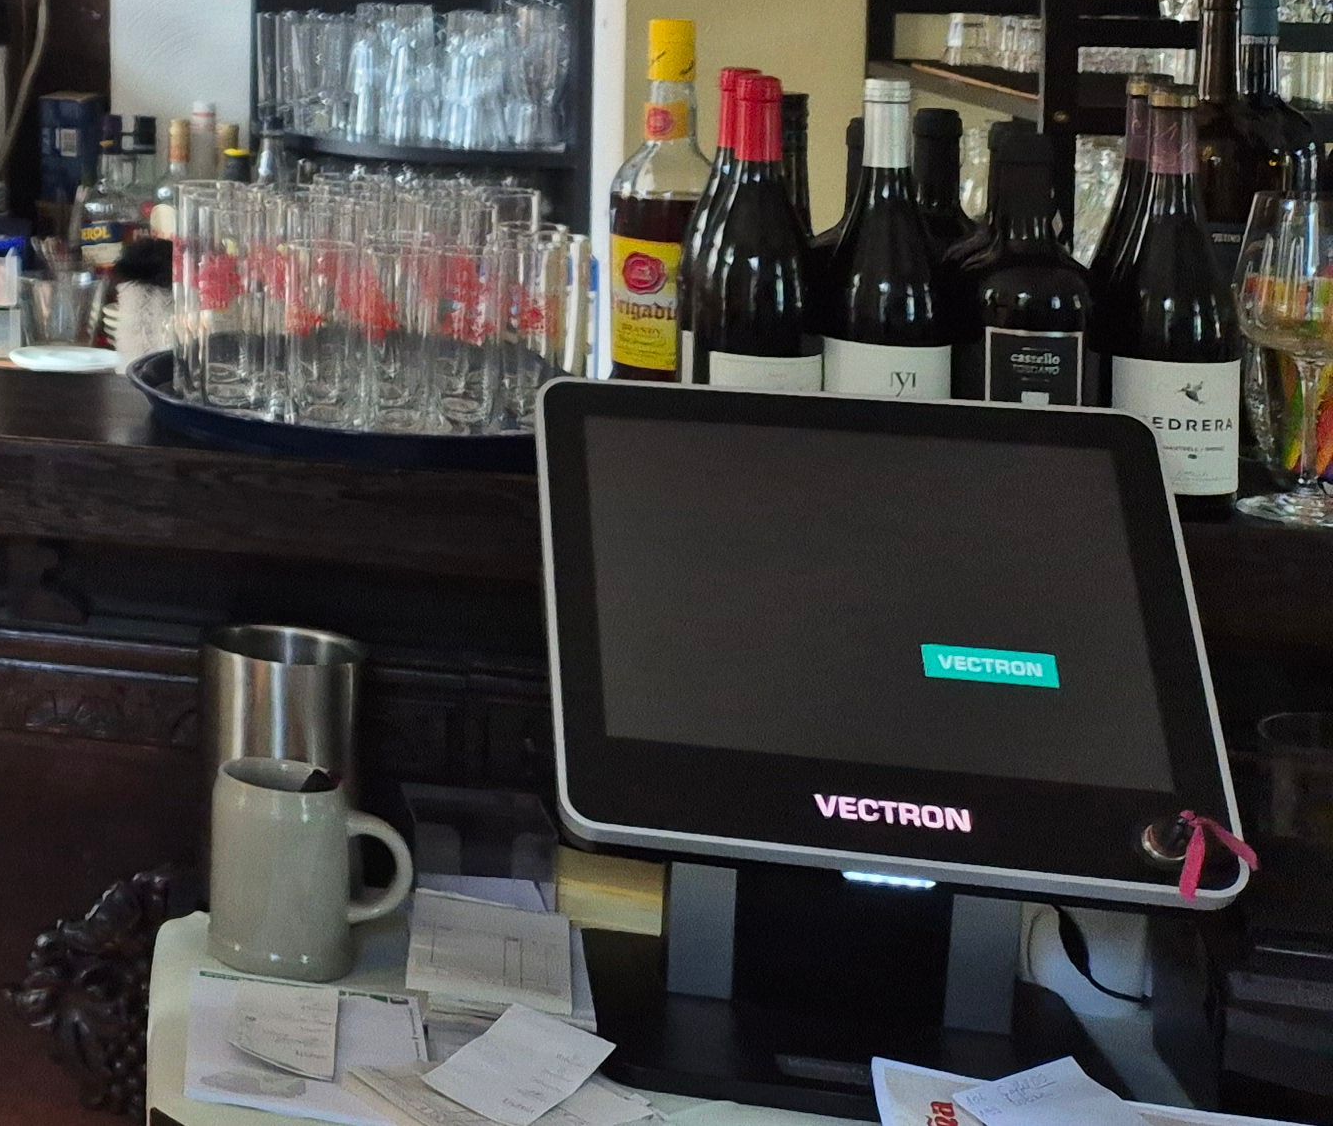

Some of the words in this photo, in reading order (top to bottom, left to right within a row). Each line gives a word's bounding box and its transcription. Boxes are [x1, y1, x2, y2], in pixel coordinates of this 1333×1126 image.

[1152, 416, 1234, 432] EDRERA
[937, 653, 1044, 678] VECTRON
[813, 792, 973, 833] VECTRON
